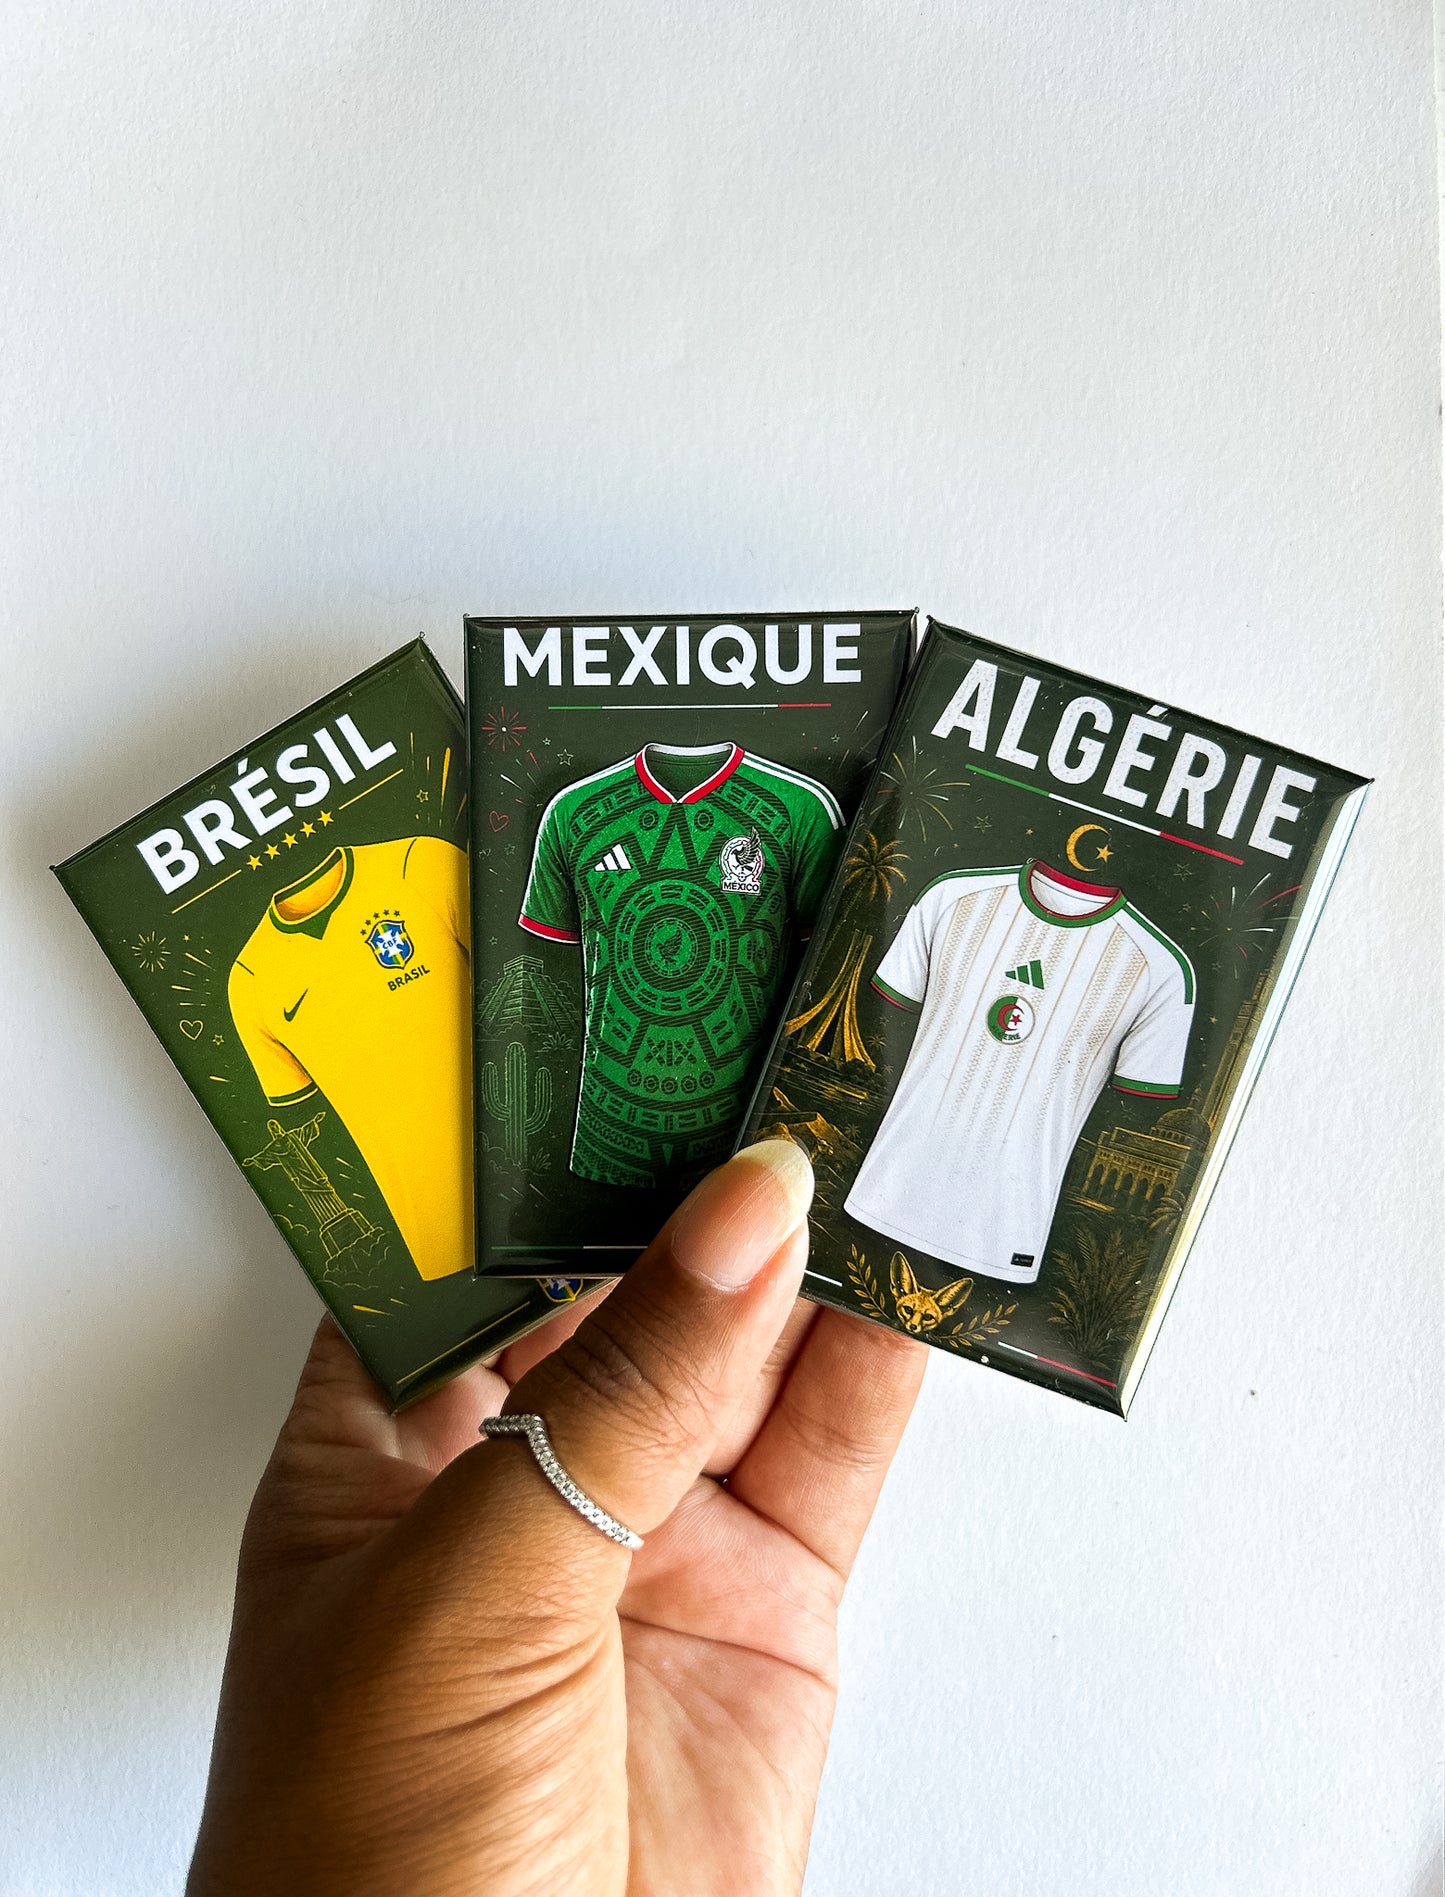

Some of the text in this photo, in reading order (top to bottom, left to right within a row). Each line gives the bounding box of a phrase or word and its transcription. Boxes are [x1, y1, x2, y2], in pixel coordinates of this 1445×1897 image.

[503, 623, 862, 690] MEXIQUE
[136, 714, 397, 895] BRÉSIL
[930, 658, 1317, 860] ALGÉRIE
[387, 965, 430, 991] BRASIL
